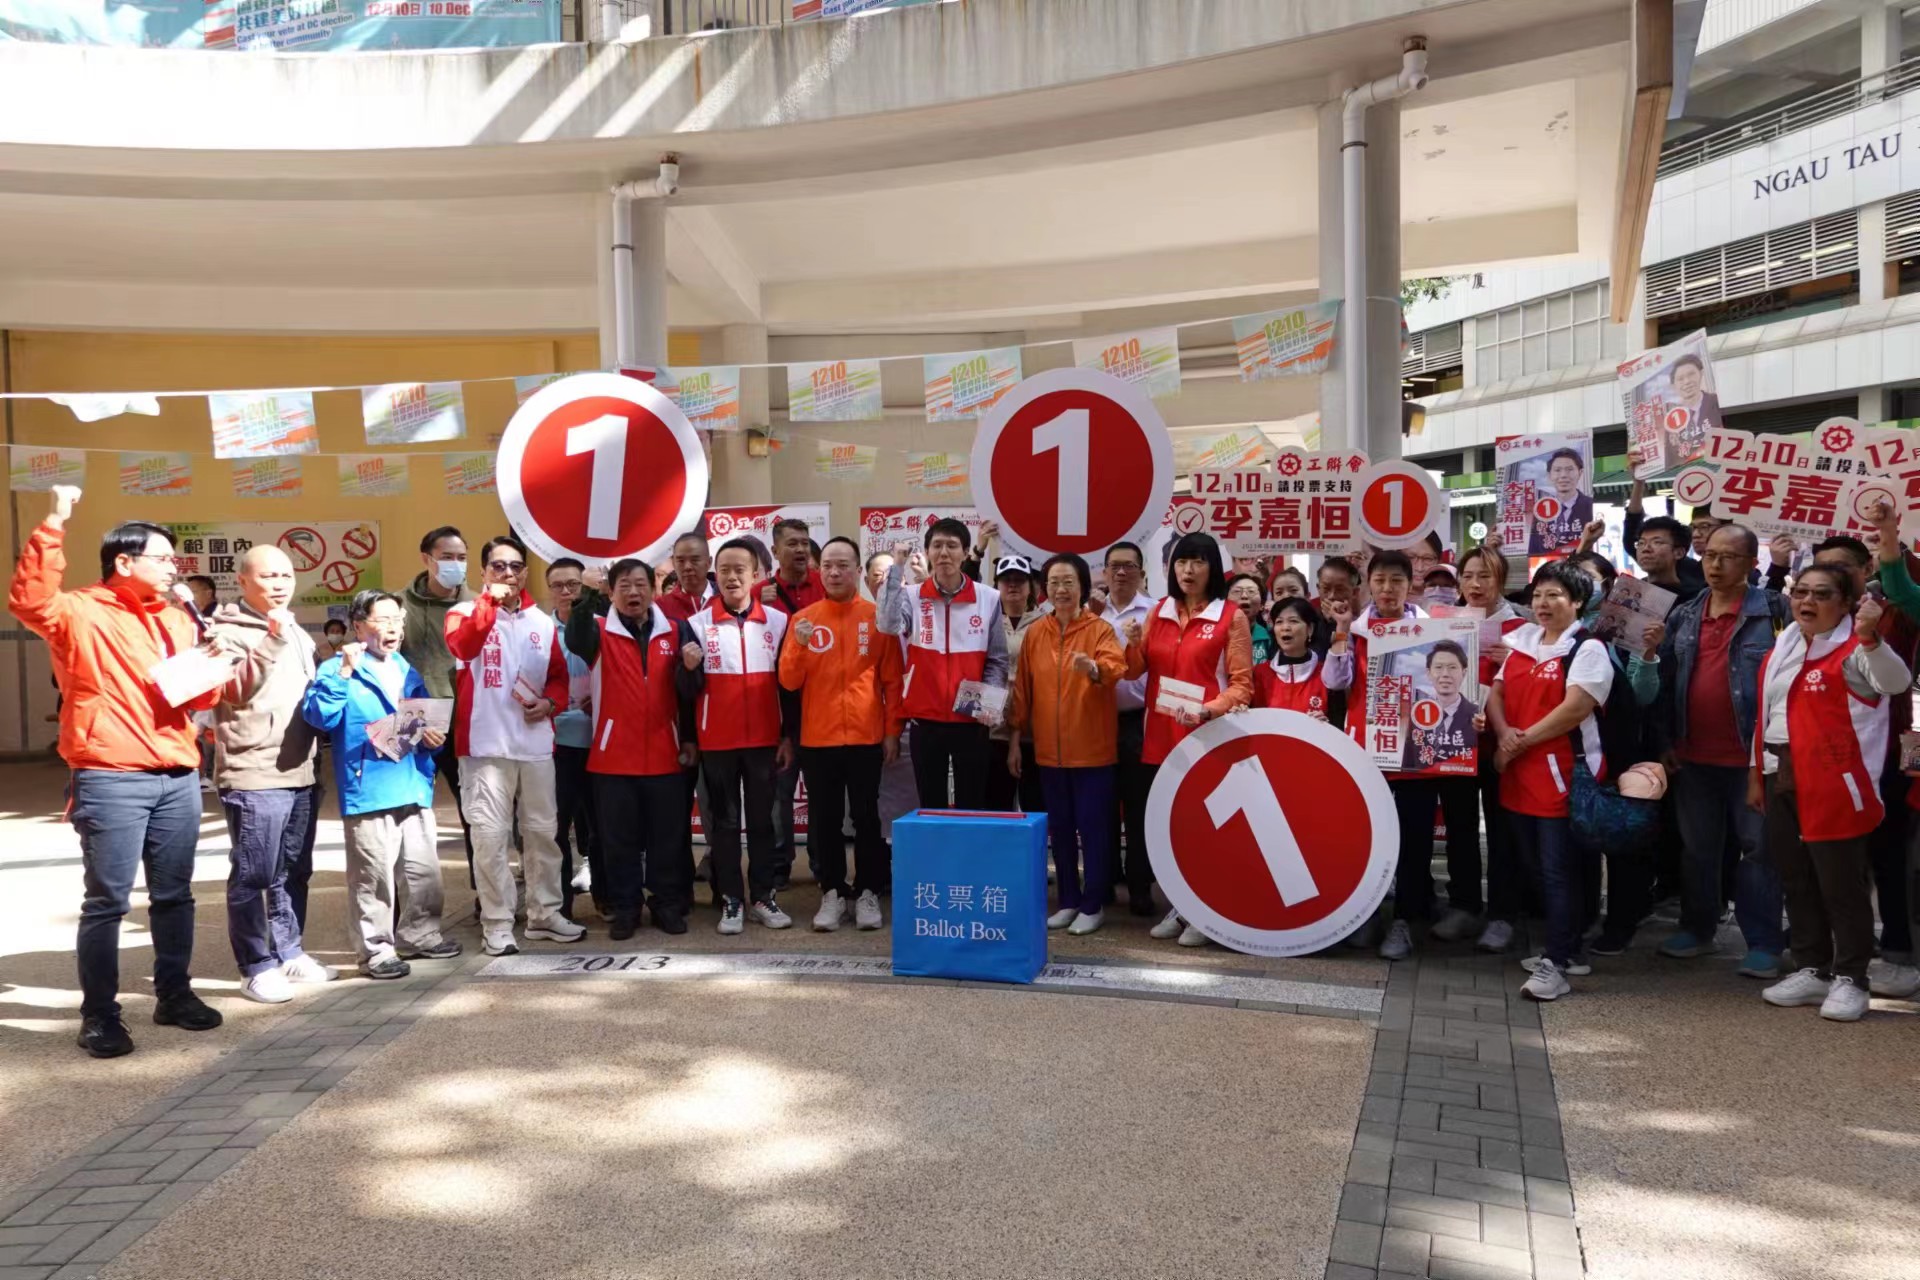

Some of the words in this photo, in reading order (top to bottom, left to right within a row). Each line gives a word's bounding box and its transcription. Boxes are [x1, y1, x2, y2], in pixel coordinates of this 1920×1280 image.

[429, 3, 444, 14] 10
[446, 3, 470, 15] Dec
[278, 27, 295, 38] vote
[297, 25, 305, 33] at
[307, 20, 319, 29] DC
[320, 14, 353, 27] election
[286, 30, 330, 46] community
[1753, 156, 1830, 200] NGAU
[1843, 132, 1902, 170] TAU
[1264, 310, 1306, 339] 1210
[1102, 338, 1140, 369] 1210
[811, 361, 847, 388] 1210
[950, 355, 988, 384] 1210
[1671, 411, 1681, 427] 1
[29, 452, 59, 469] 1210
[1711, 434, 1809, 469] 12月10日
[356, 457, 385, 475] 1210
[1032, 409, 1090, 537] 1
[1306, 455, 1366, 475] 工聯會
[566, 414, 628, 541] 1
[1194, 472, 1273, 493] 12月10日
[1277, 480, 1352, 493] 請投票支持
[1382, 480, 1404, 529] 1
[1503, 481, 1525, 545] 李嘉恒
[1542, 500, 1552, 517] 1
[1210, 497, 1352, 540] 李嘉恒
[1472, 526, 1484, 538] 56
[184, 538, 253, 555] 範圍內
[815, 629, 823, 647] 1
[1387, 624, 1424, 638] 工聯會
[1373, 674, 1400, 754] 李嘉恒
[1420, 703, 1431, 724] 1
[1203, 754, 1321, 908] 1
[913, 882, 1009, 914] 投票箱
[914, 917, 966, 940] Ballot
[970, 921, 1008, 942] Box
[550, 955, 672, 972] 2013
